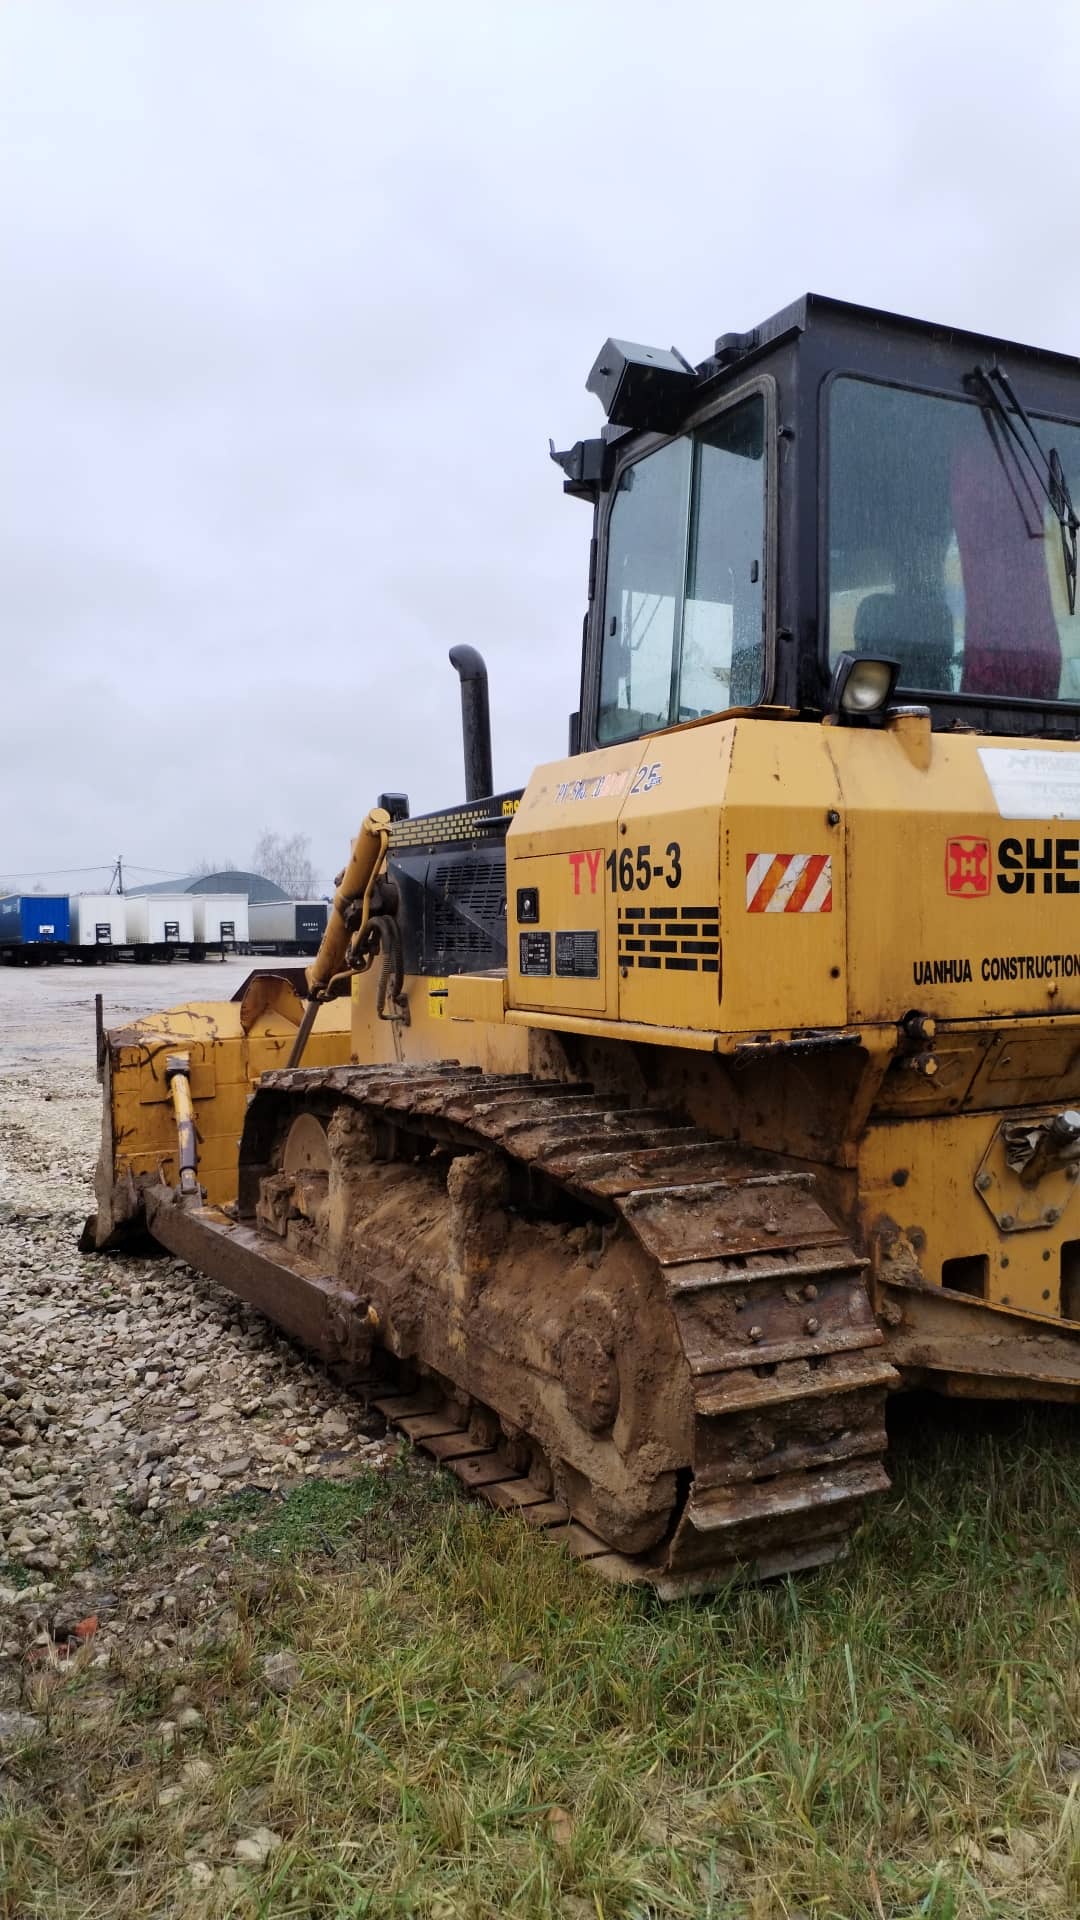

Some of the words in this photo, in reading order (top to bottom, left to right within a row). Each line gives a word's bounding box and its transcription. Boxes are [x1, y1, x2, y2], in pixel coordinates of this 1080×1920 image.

[996, 838, 1080, 894] SHE
[913, 959, 972, 985] UANHUA
[981, 954, 1080, 981] CONSTRUCTION
